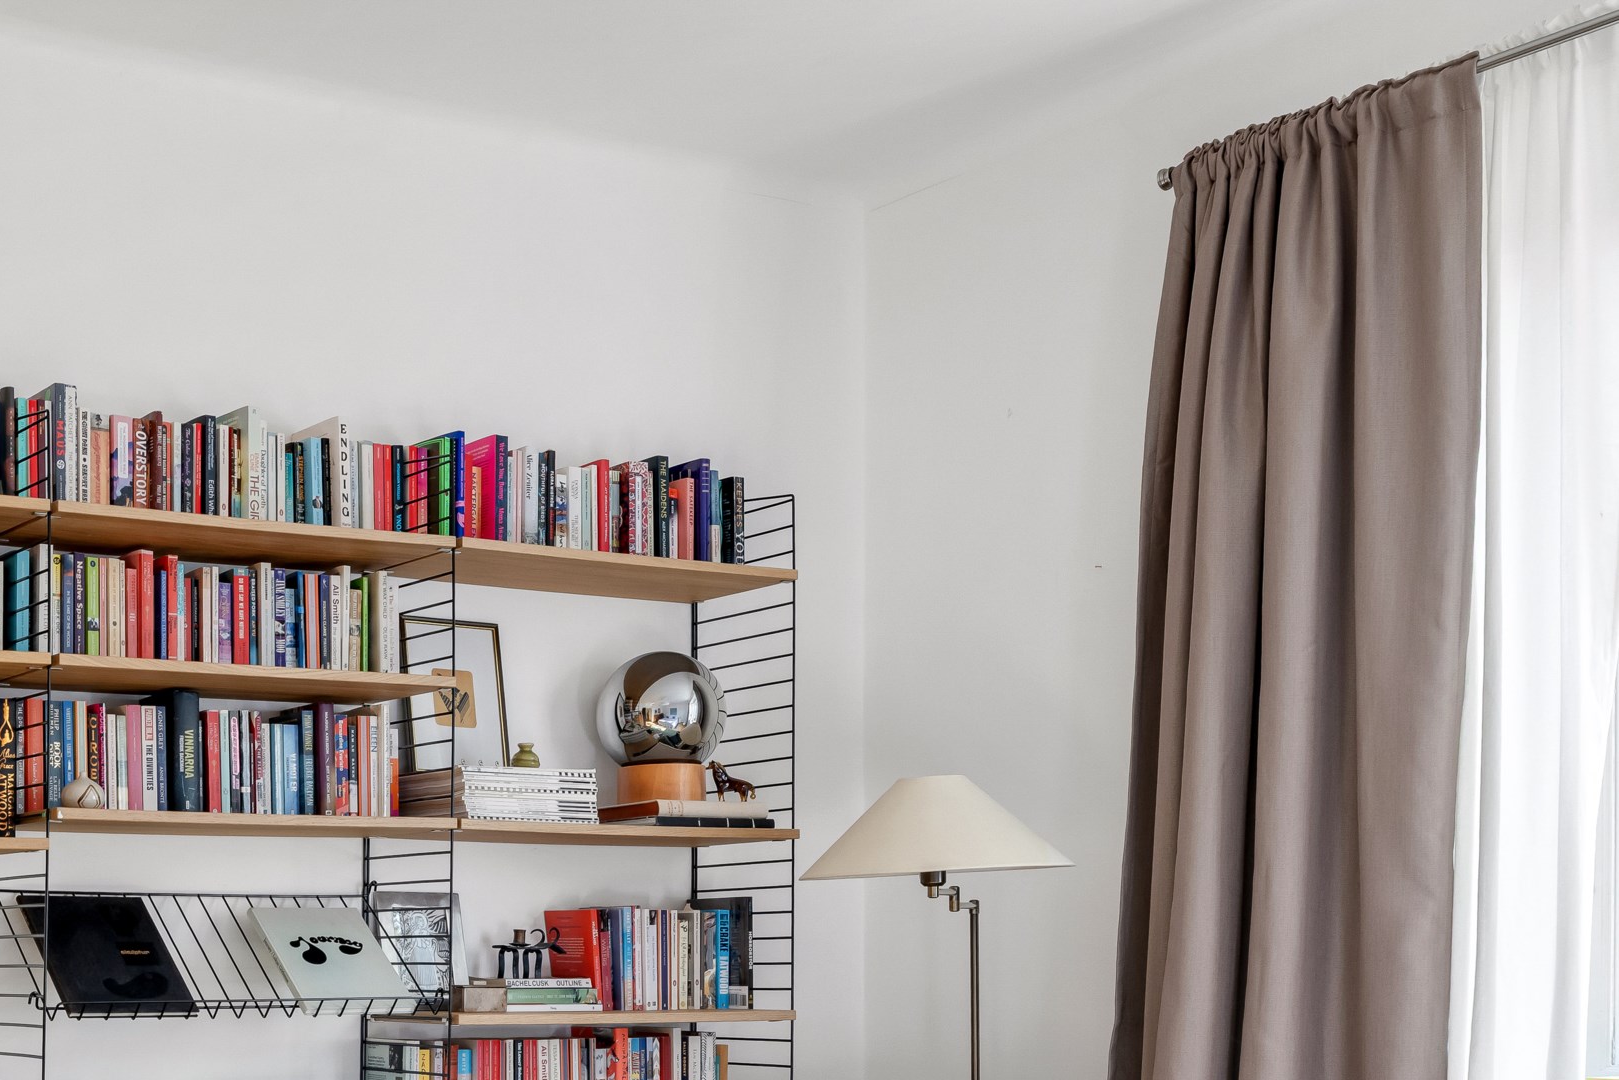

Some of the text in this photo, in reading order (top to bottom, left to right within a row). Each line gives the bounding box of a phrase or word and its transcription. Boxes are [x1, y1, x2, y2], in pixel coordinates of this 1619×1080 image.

[56, 420, 65, 456] MAUS
[136, 431, 147, 505] OVERSTORY
[250, 475, 259, 496] THE
[75, 602, 83, 629] Space
[276, 639, 285, 653] MOO
[185, 730, 194, 778] VINNARNA
[720, 927, 729, 952] CRAKE
